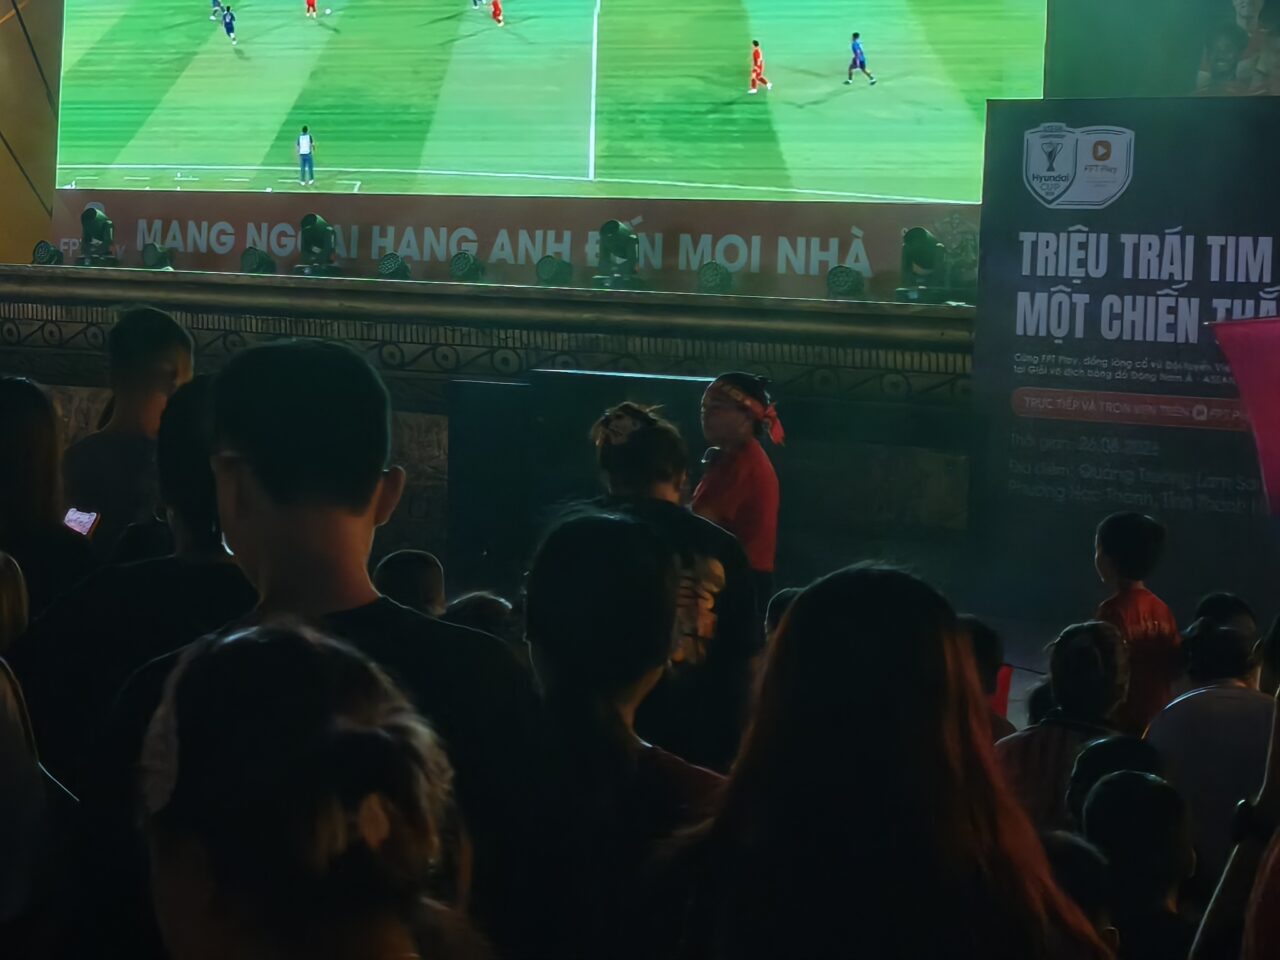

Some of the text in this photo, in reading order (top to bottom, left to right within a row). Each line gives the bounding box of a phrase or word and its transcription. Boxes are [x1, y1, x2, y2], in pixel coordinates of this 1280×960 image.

[1032, 173, 1070, 184] Hyundai
[136, 218, 236, 256] MANG
[488, 227, 572, 266] ANH
[777, 225, 873, 277] NHÀ
[1019, 224, 1273, 284] TRIỆU TRÁI TIM
[1015, 284, 1090, 344] MỘT
[1100, 281, 1200, 344] CHIẾN
